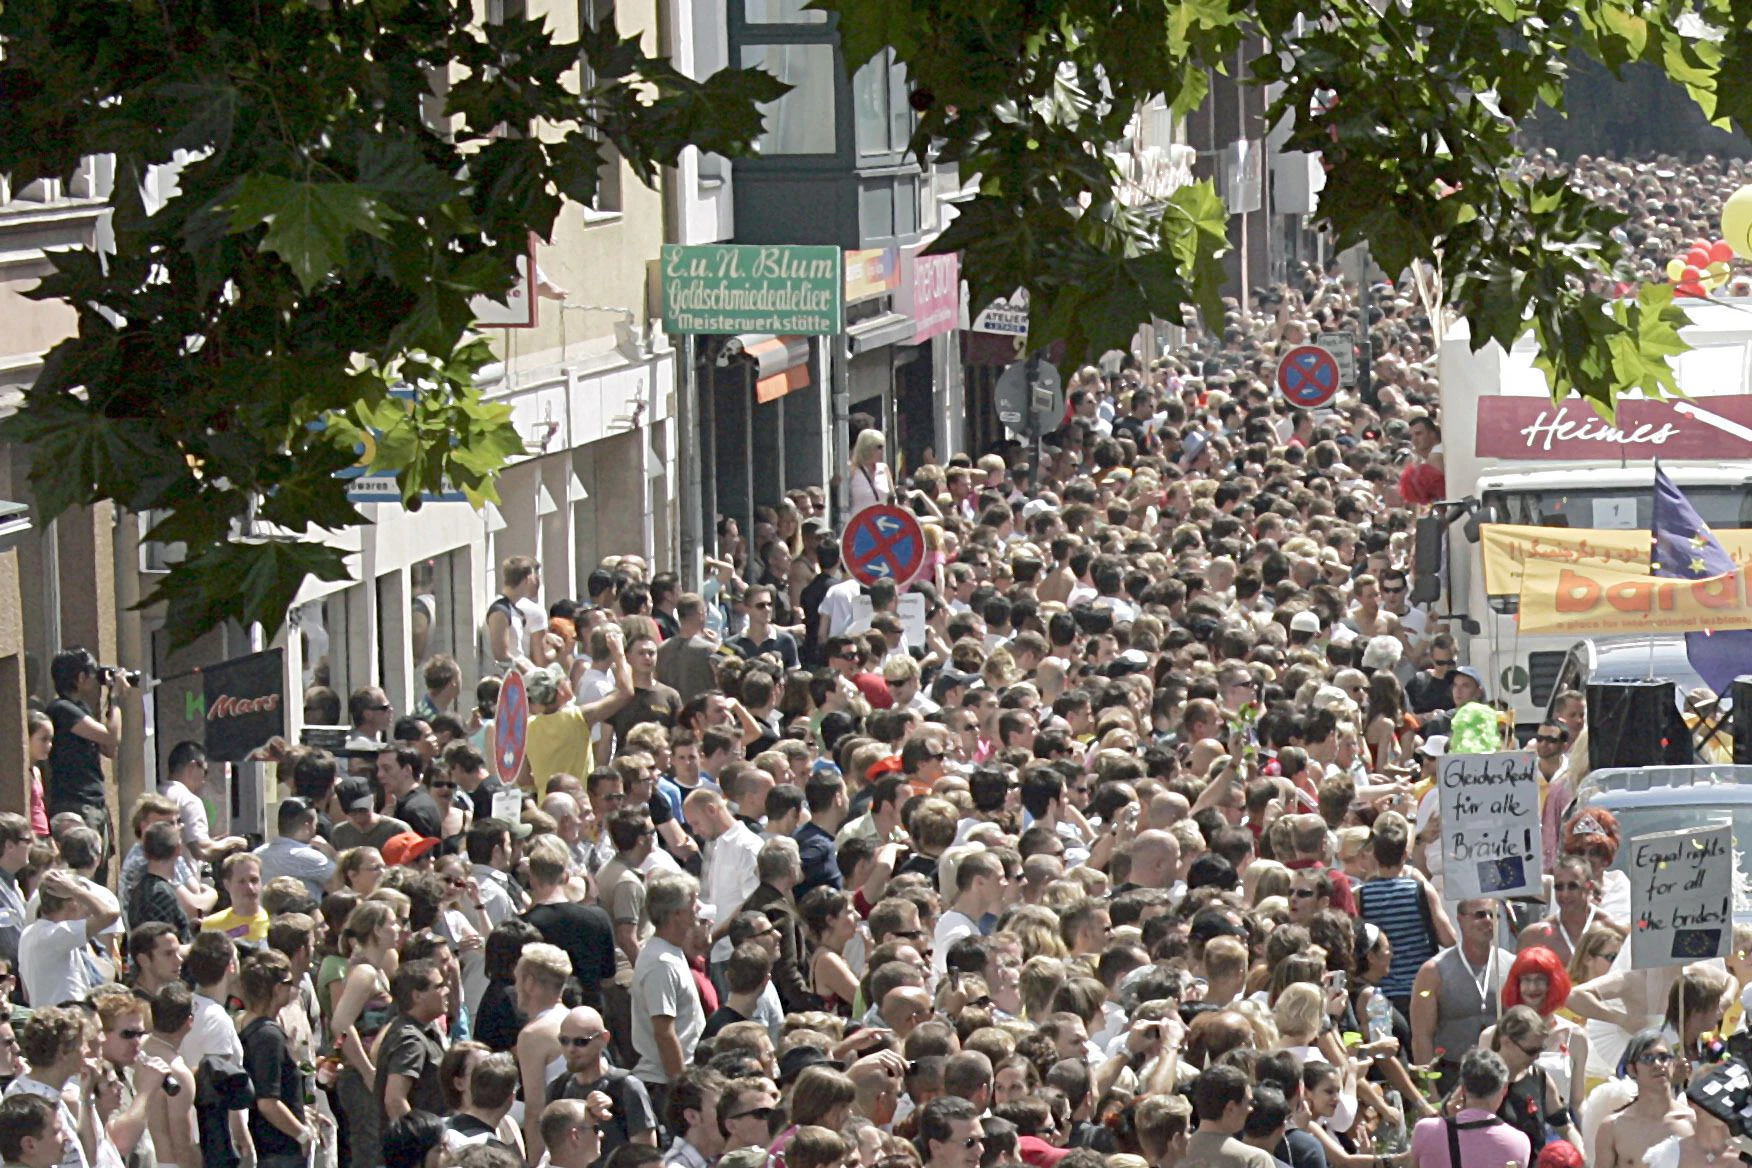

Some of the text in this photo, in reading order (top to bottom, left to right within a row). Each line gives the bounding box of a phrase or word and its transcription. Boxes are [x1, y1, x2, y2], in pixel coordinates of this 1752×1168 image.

[752, 246, 833, 279] Blum
[667, 279, 833, 319] Goldschmiedeatelier
[1520, 407, 1681, 451] Heimes
[207, 694, 279, 720] Mars
[1444, 759, 1503, 788] Gleiches
[1452, 792, 1529, 821] für alle
[1636, 840, 1683, 874] Equal
[1646, 869, 1706, 902] for all
